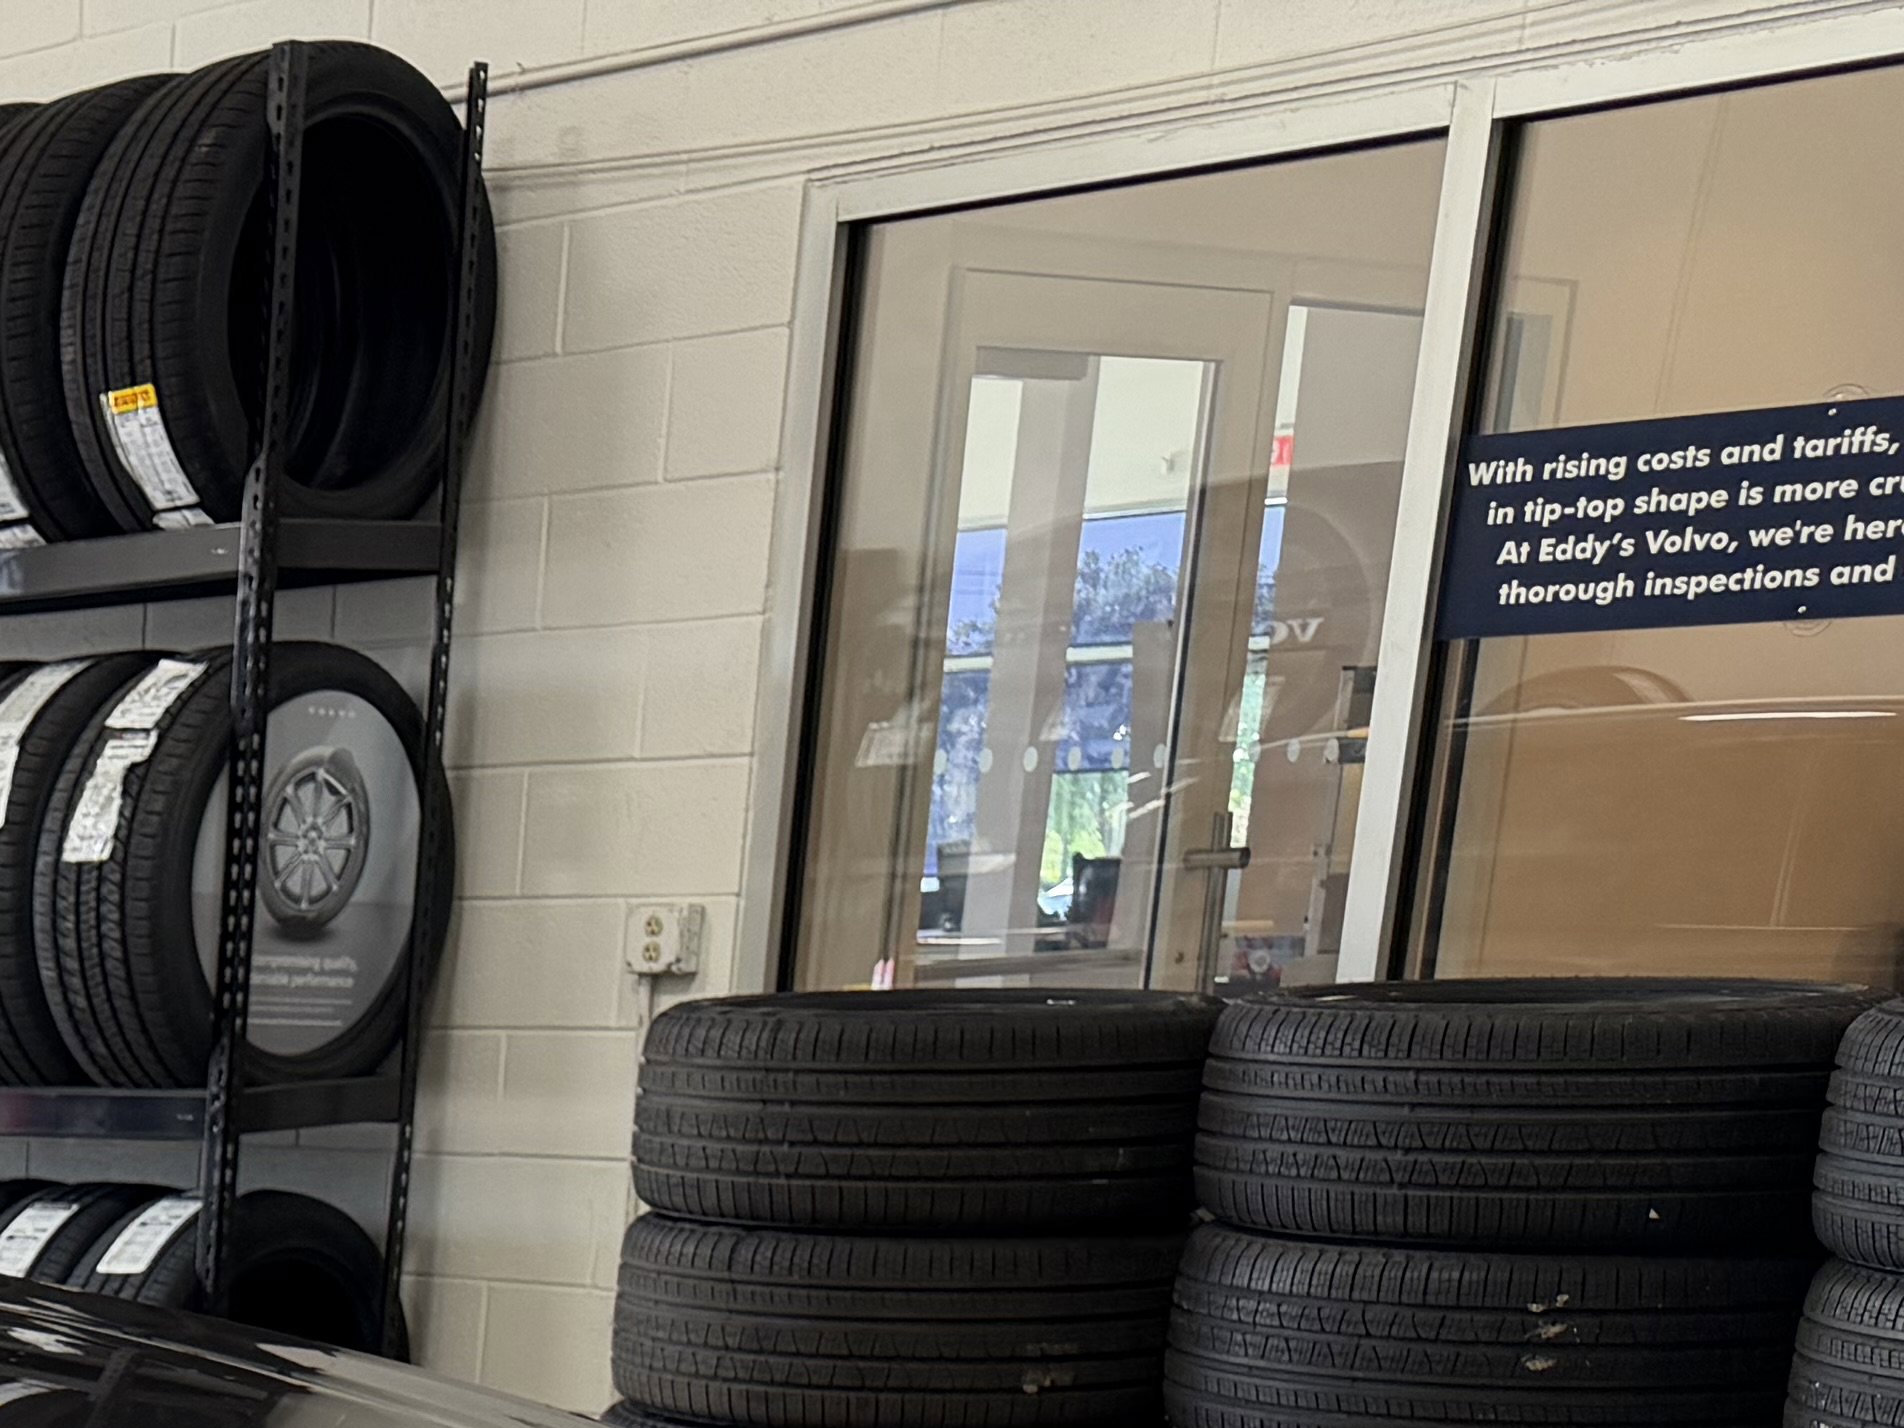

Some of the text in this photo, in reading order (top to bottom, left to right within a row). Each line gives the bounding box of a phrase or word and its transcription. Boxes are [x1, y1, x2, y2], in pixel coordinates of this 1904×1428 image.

[1468, 426, 1900, 486] With rising costs and tariffs,
[1487, 474, 1904, 528] in tip-top shape is more cr
[1497, 538, 1531, 565] At
[1646, 527, 1739, 556] Volvo,
[1749, 519, 1834, 548] we're
[1844, 514, 1904, 541] her
[1499, 555, 1896, 605] thorough inspections and
